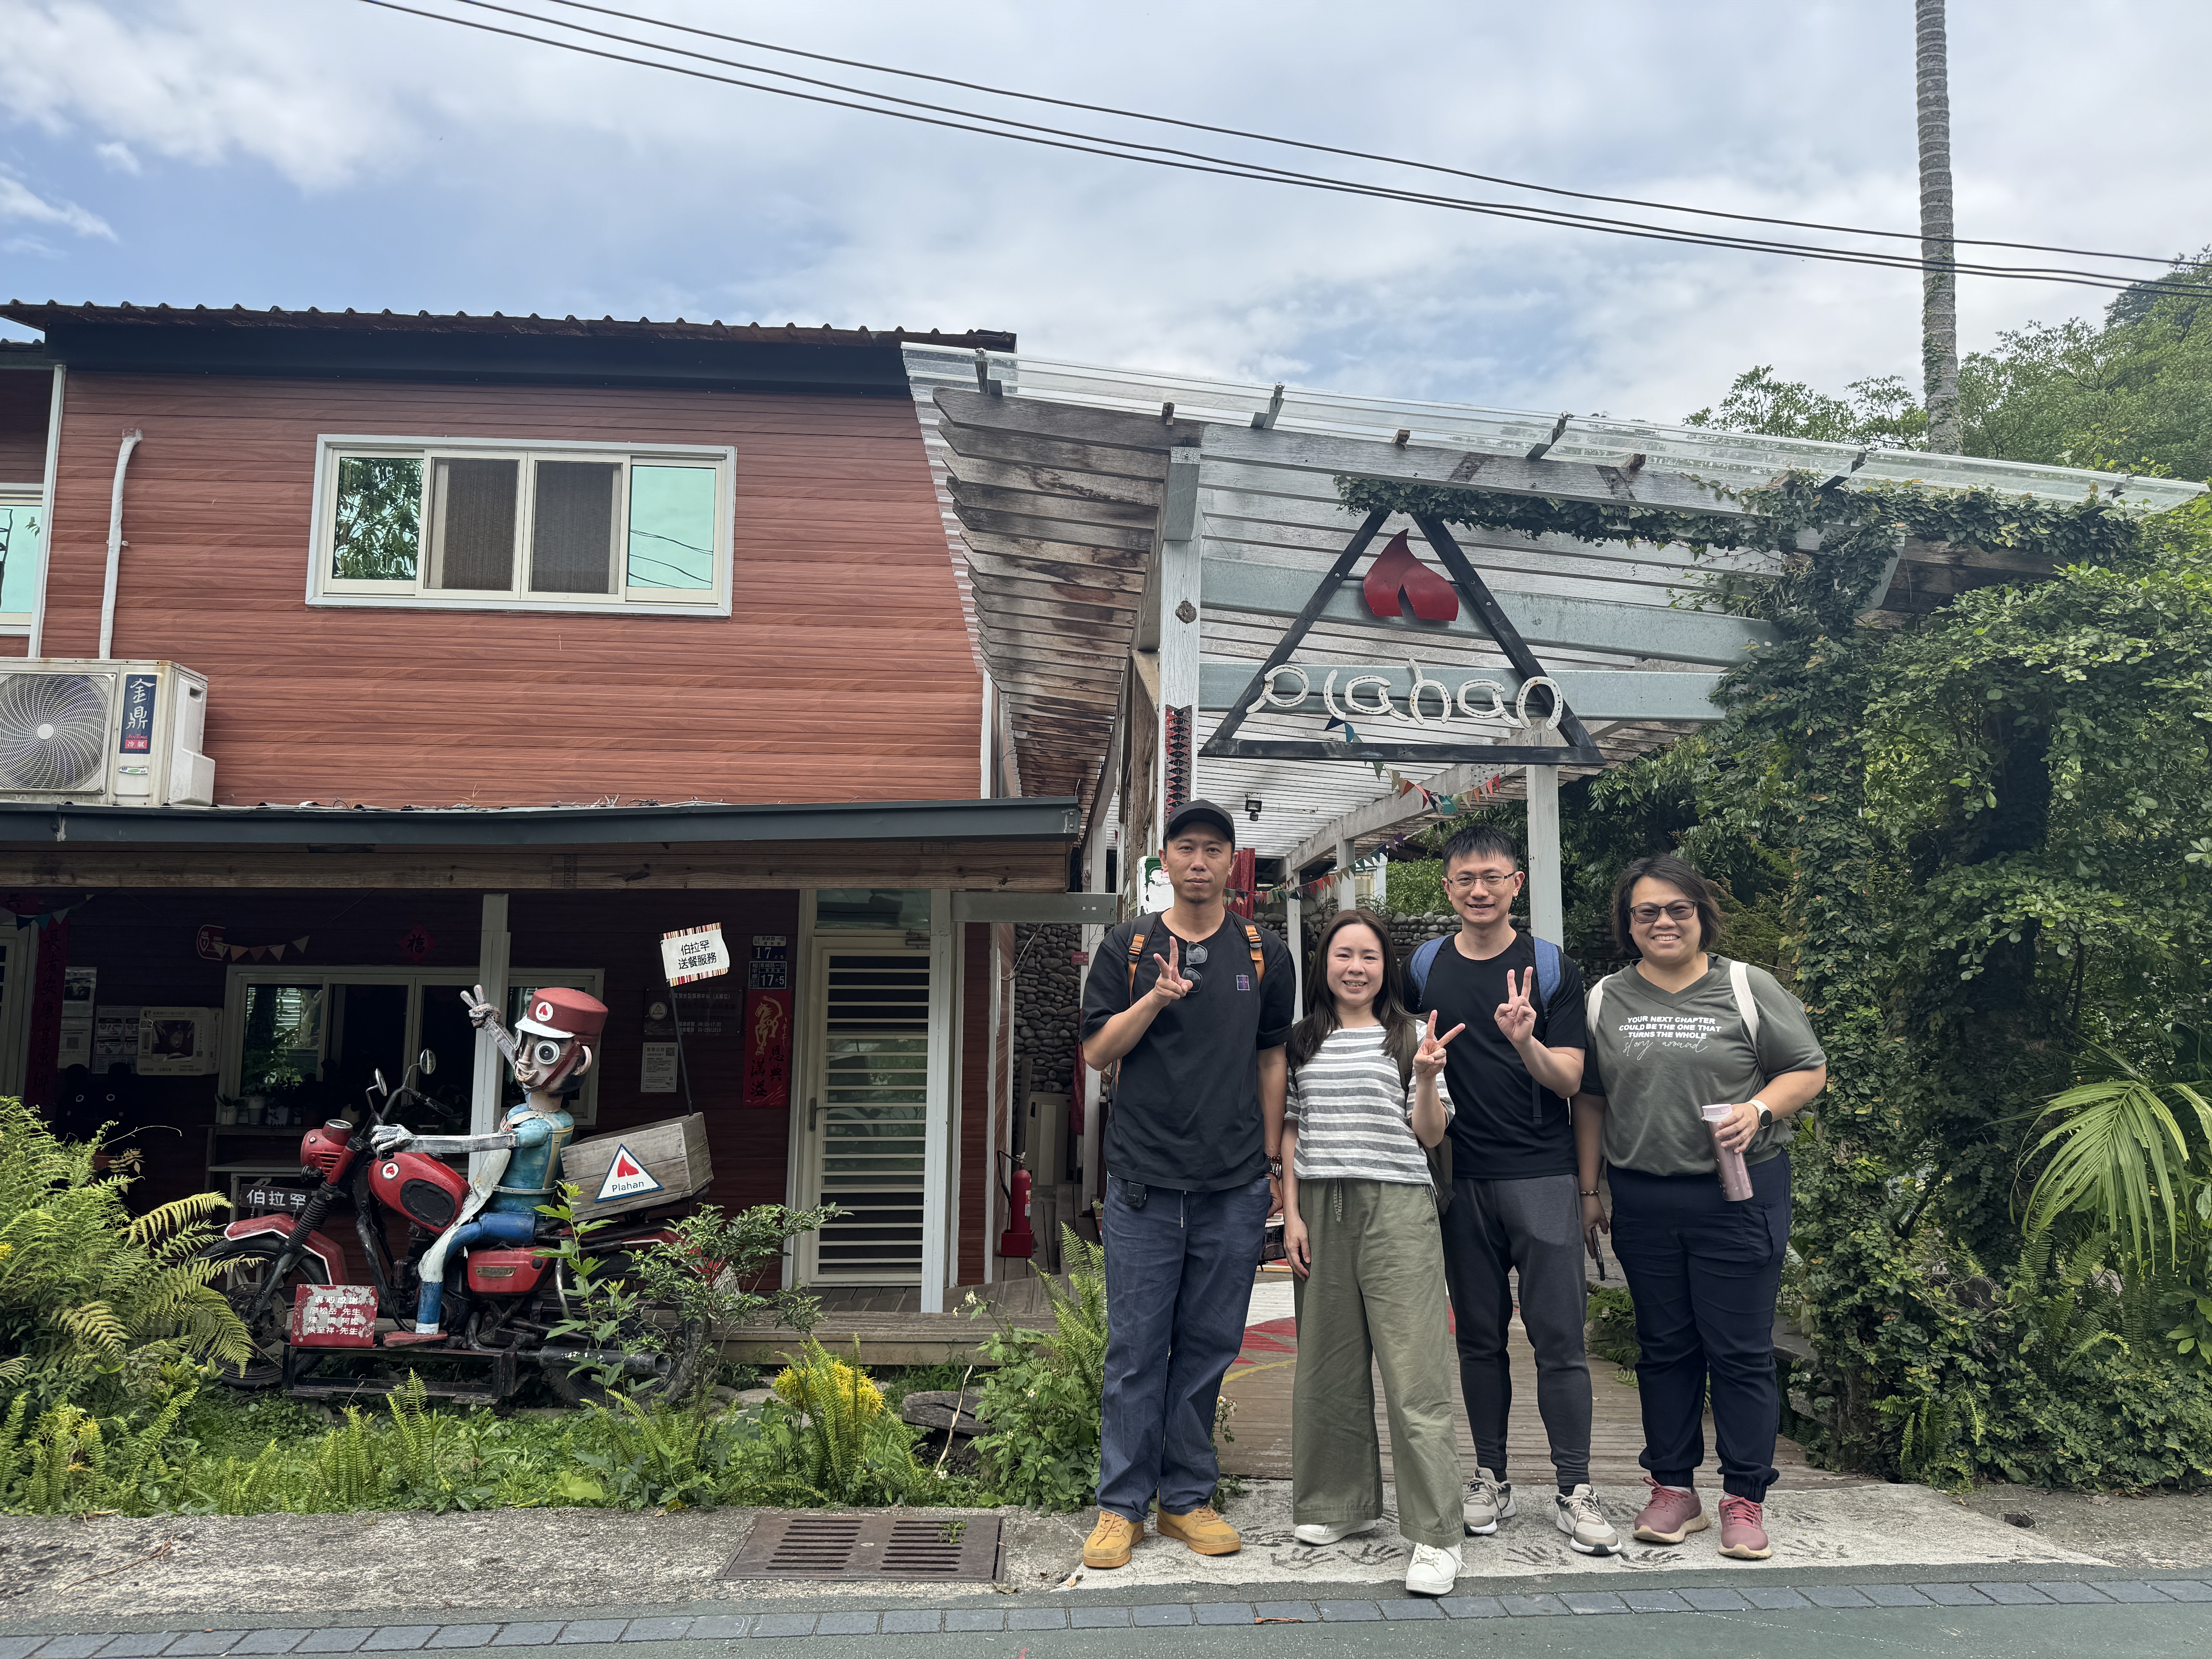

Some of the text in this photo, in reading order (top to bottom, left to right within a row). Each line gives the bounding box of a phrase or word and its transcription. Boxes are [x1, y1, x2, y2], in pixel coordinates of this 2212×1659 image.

[126, 678, 156, 729] 金鼎
[681, 939, 710, 956] 伯拉罕
[678, 952, 716, 970] 送餐服務
[1674, 1017, 1716, 1025] CHAPTER
[1623, 1030, 1708, 1061] story around
[769, 1044, 785, 1082] 恩典
[750, 1058, 768, 1097] 滿溢
[612, 1182, 644, 1192] Plahan
[246, 1189, 307, 1209] 伯拉罕
[314, 1295, 359, 1305] 衷心感謝
[309, 1307, 361, 1316] 廖松岳 先生
[307, 1326, 359, 1335] 侯至祥 先生
